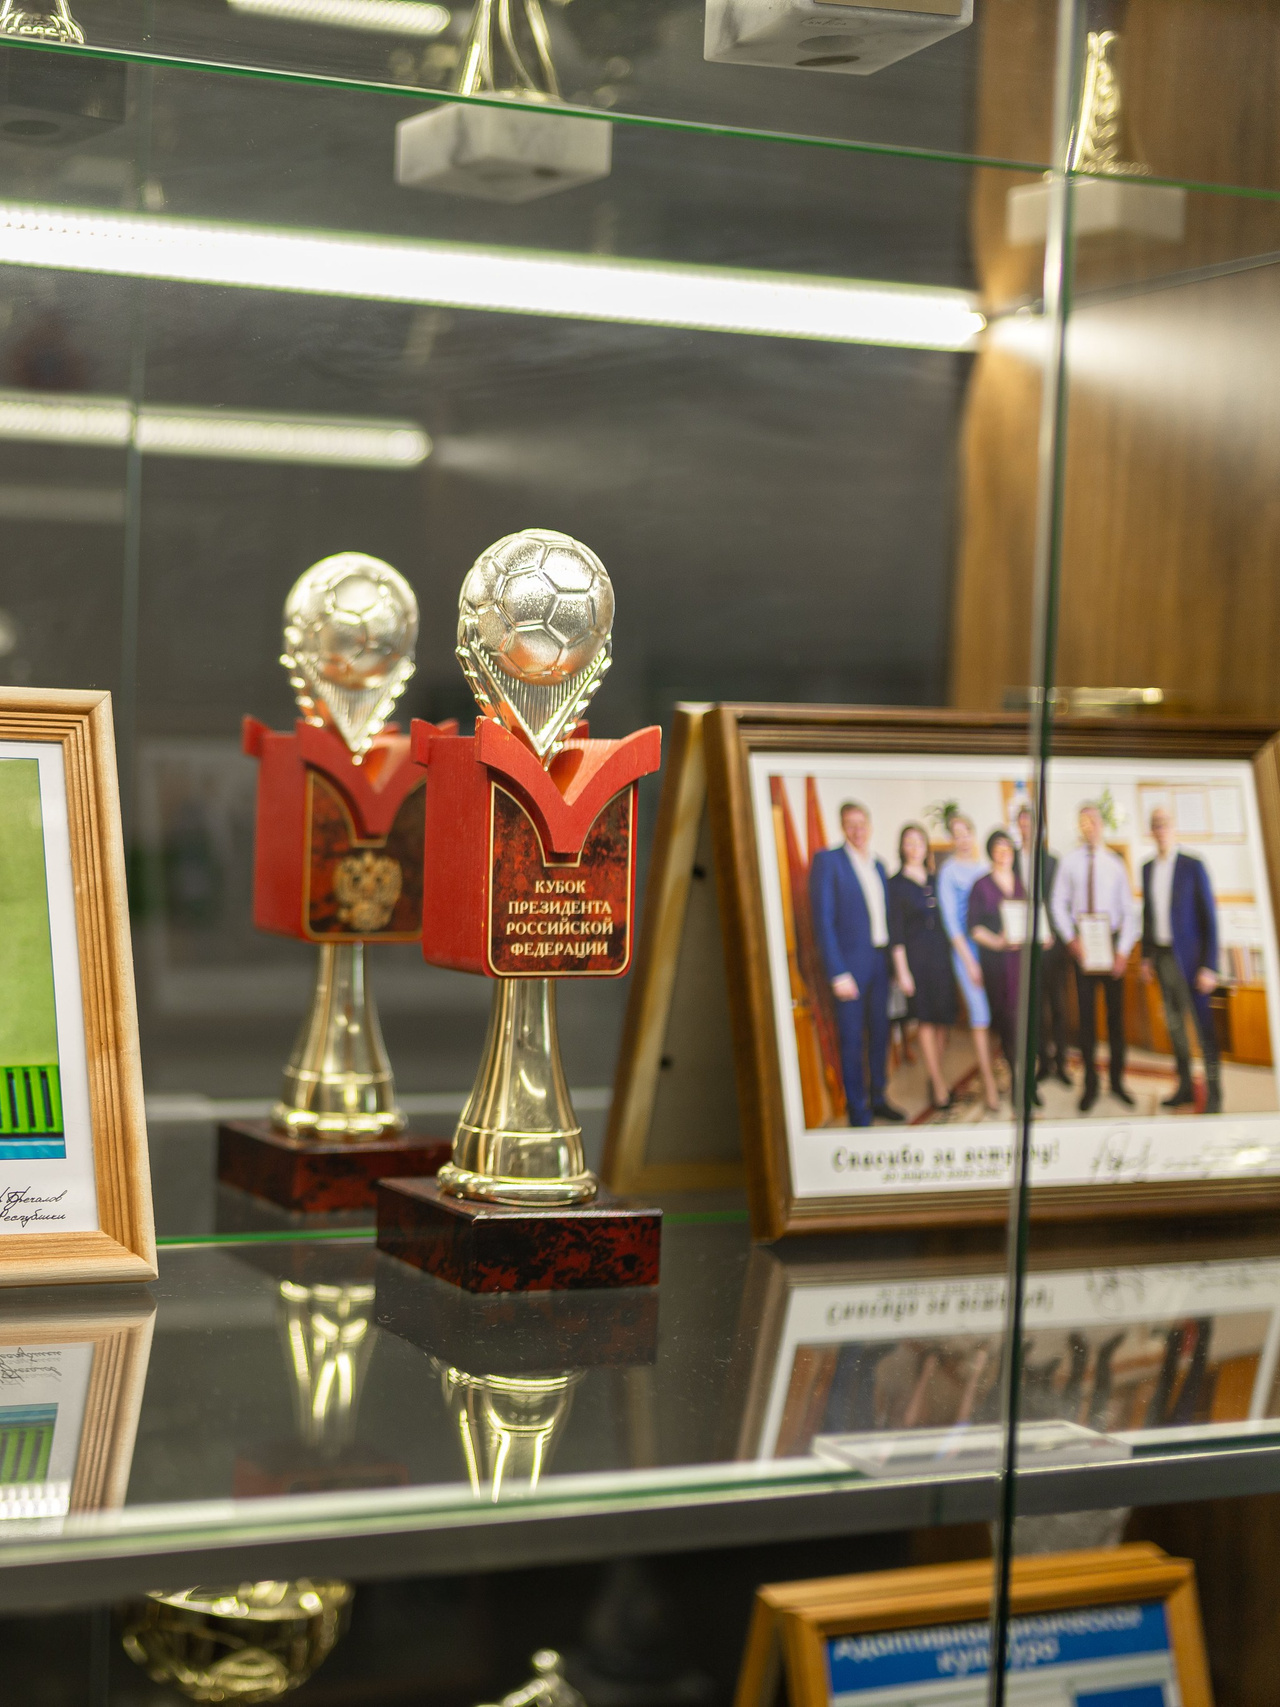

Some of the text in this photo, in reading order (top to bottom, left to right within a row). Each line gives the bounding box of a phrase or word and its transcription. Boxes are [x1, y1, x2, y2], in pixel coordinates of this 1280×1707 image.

[535, 880, 586, 894] КУБОК
[508, 900, 612, 916] ПРЕЗИДЕНТА
[506, 916, 614, 935] РОССИЙСКОЙ
[510, 941, 609, 958] ФЕДЕРАЦИИ
